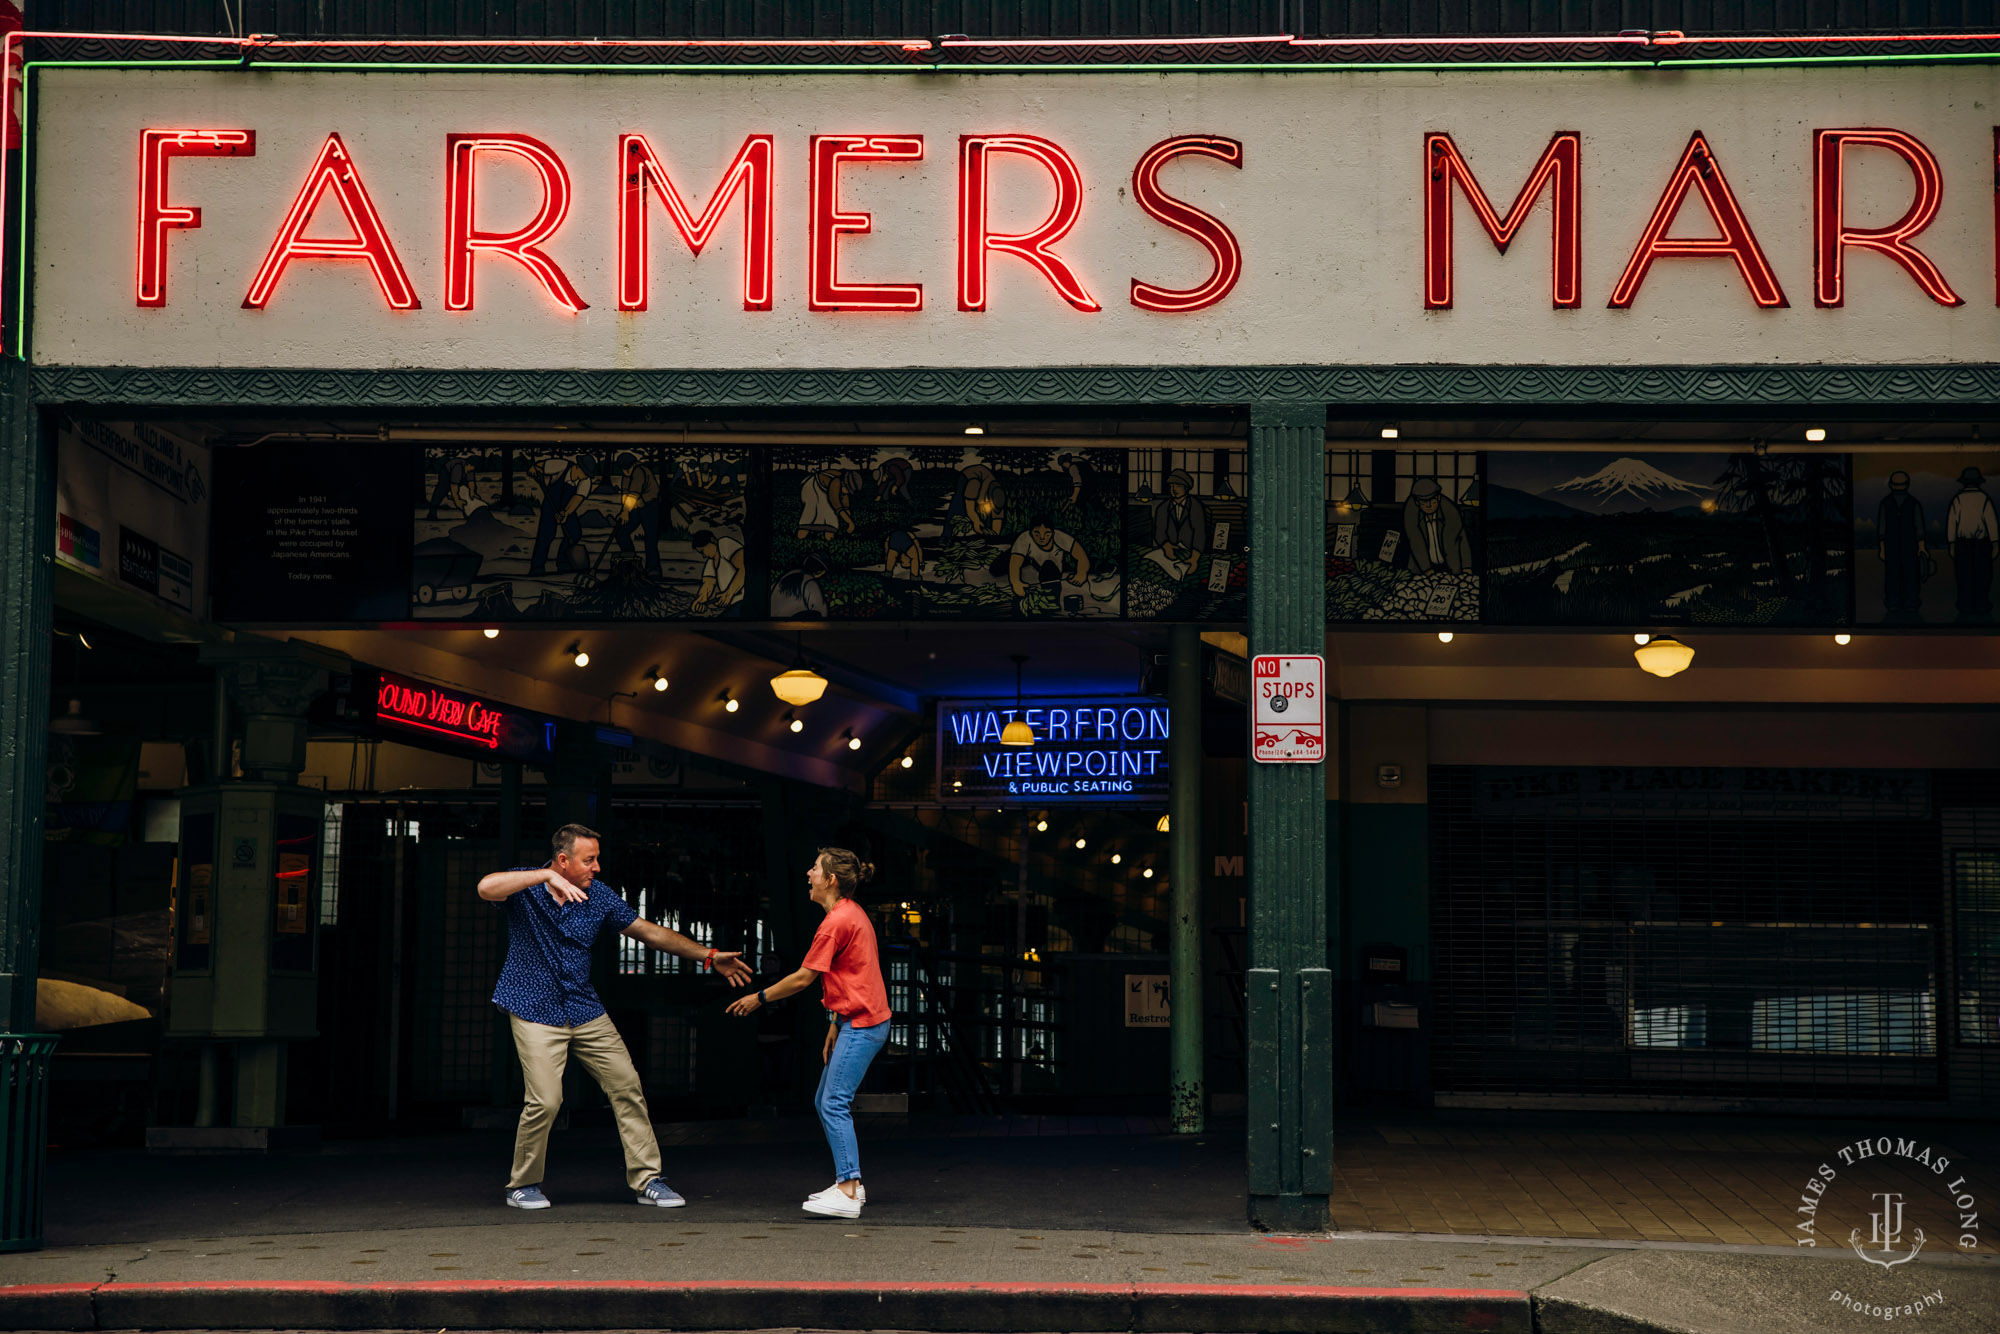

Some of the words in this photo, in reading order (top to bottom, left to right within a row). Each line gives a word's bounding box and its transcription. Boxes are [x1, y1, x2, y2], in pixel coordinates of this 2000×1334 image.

[137, 129, 1243, 313] FARMERS
[1423, 129, 2000, 311] MAR
[142, 448, 184, 491] VIEWPOINT
[299, 540, 334, 548] occupied
[335, 540, 344, 548] by
[272, 551, 308, 559] Japanese
[288, 572, 310, 581] Today
[1258, 661, 1276, 674] NO
[1262, 682, 1314, 698] STOPS
[428, 689, 465, 726] VIEW
[984, 750, 1161, 778] VIEWPOINT
[1008, 781, 1018, 794] &
[1022, 782, 1069, 794] PUBLIC
[1073, 780, 1132, 792] SEATING
[1487, 772, 1578, 801] PIKE
[1599, 768, 1725, 792] PLACE
[1742, 768, 1913, 801] BAKERY
